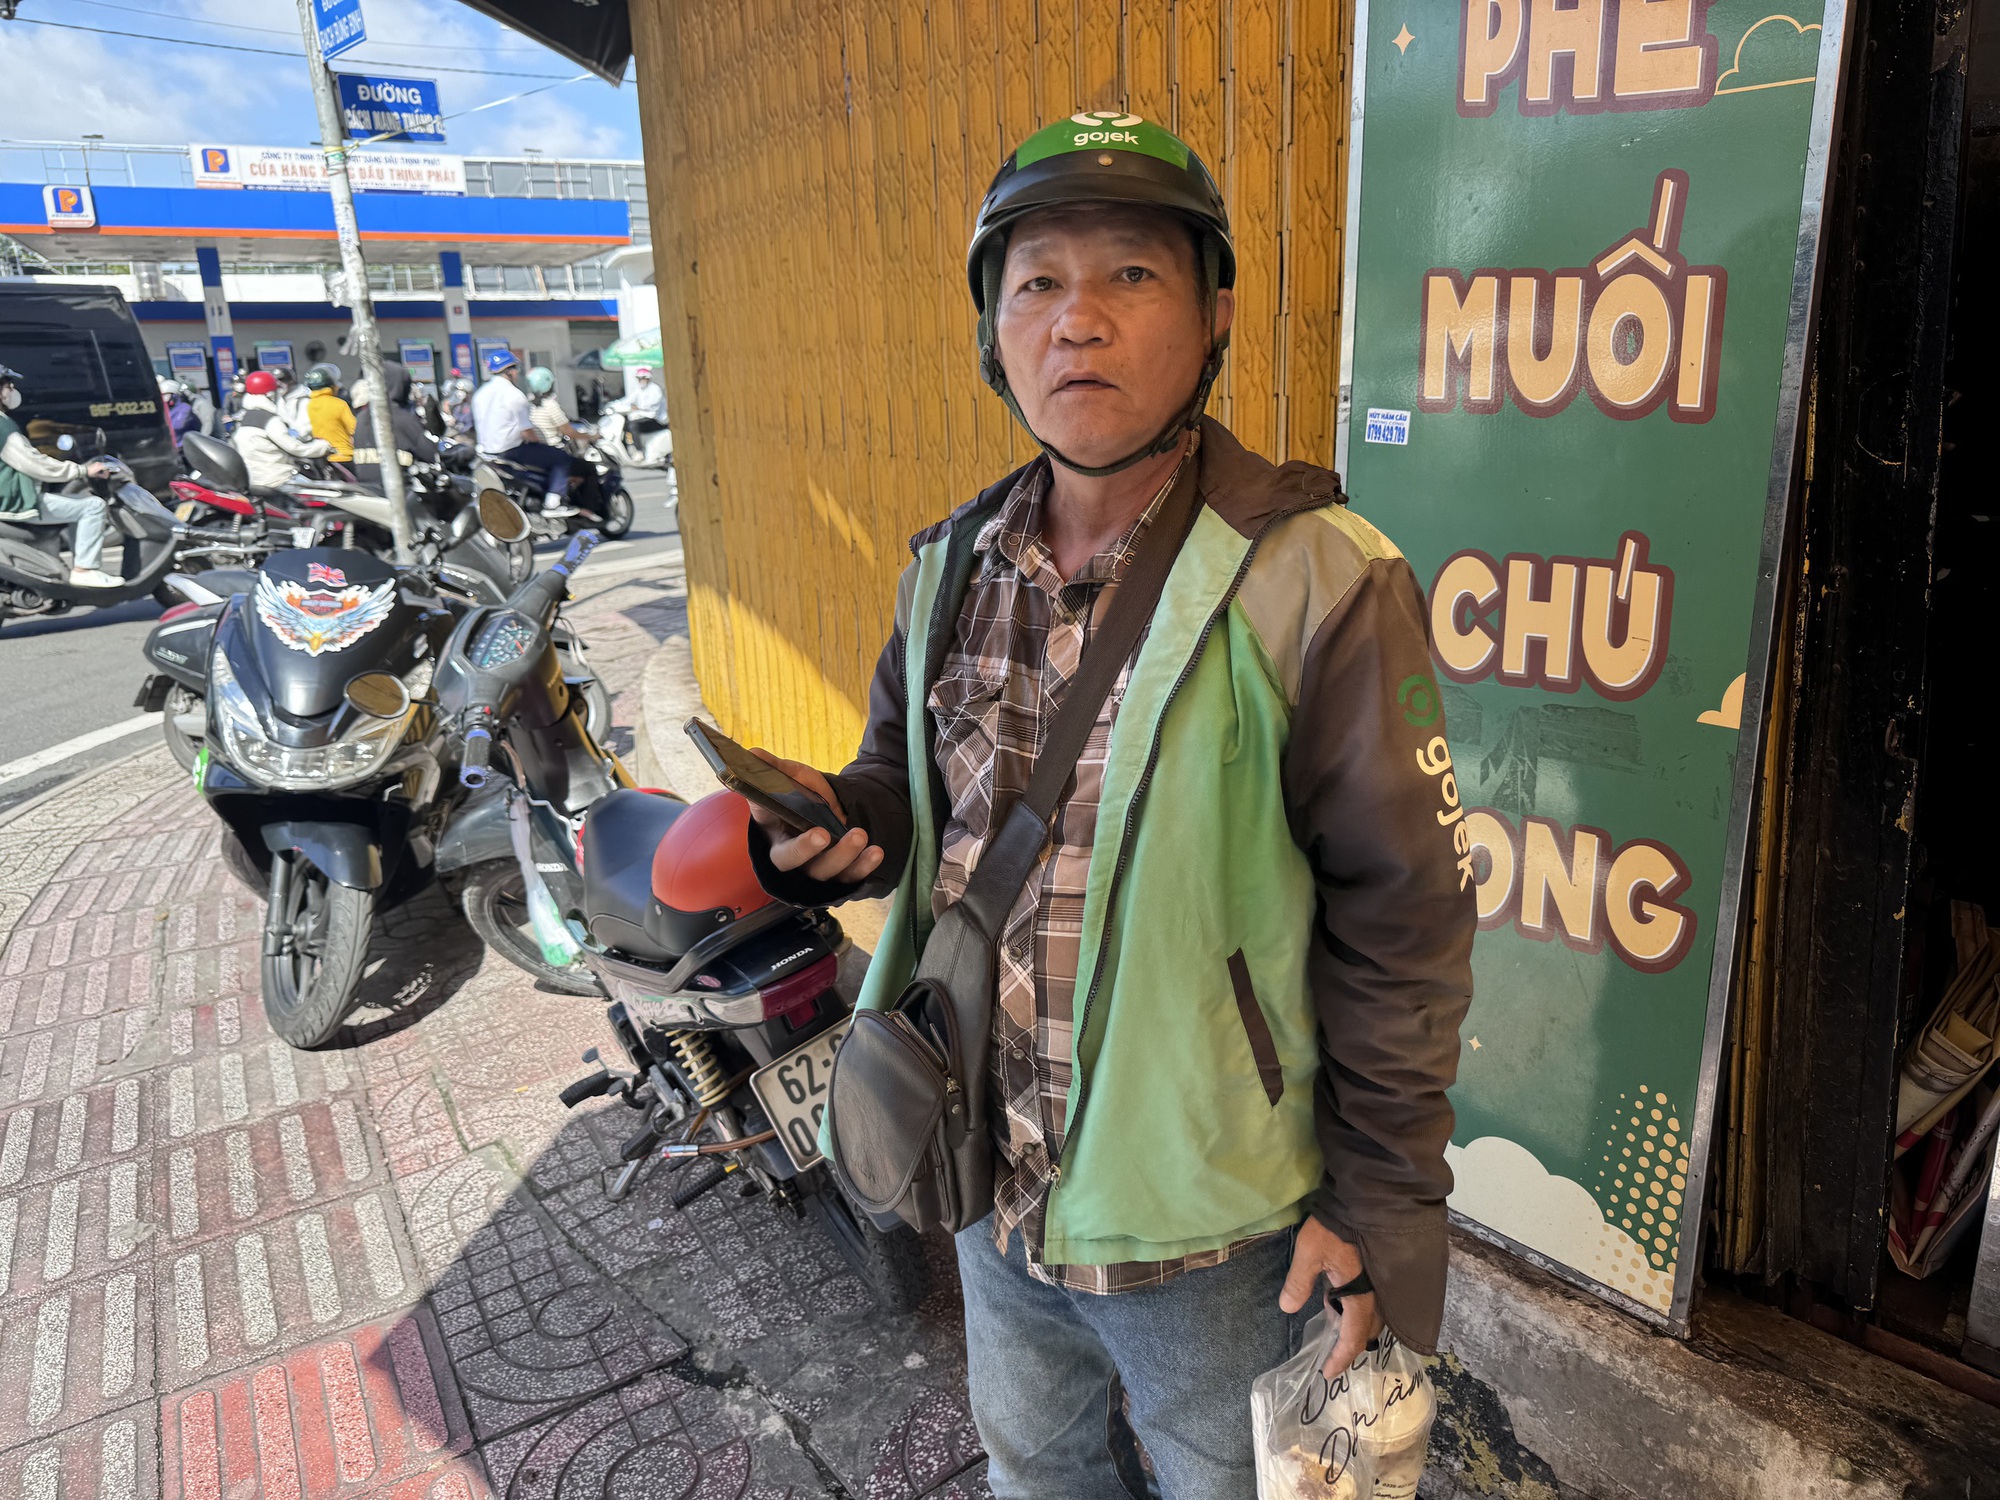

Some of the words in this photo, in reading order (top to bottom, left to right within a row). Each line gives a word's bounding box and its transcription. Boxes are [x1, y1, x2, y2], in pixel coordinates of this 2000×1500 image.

[357, 82, 422, 105] ĐƯỜNG
[344, 103, 373, 130] CÁCH
[1073, 131, 1139, 147] gojek
[281, 162, 316, 178] HÀNG
[427, 166, 456, 184] PHÁT
[1424, 178, 1712, 408] MUỐI
[1431, 538, 1661, 688] CHÚ
[1416, 735, 1475, 892] gojek
[770, 946, 814, 972] HONDA
